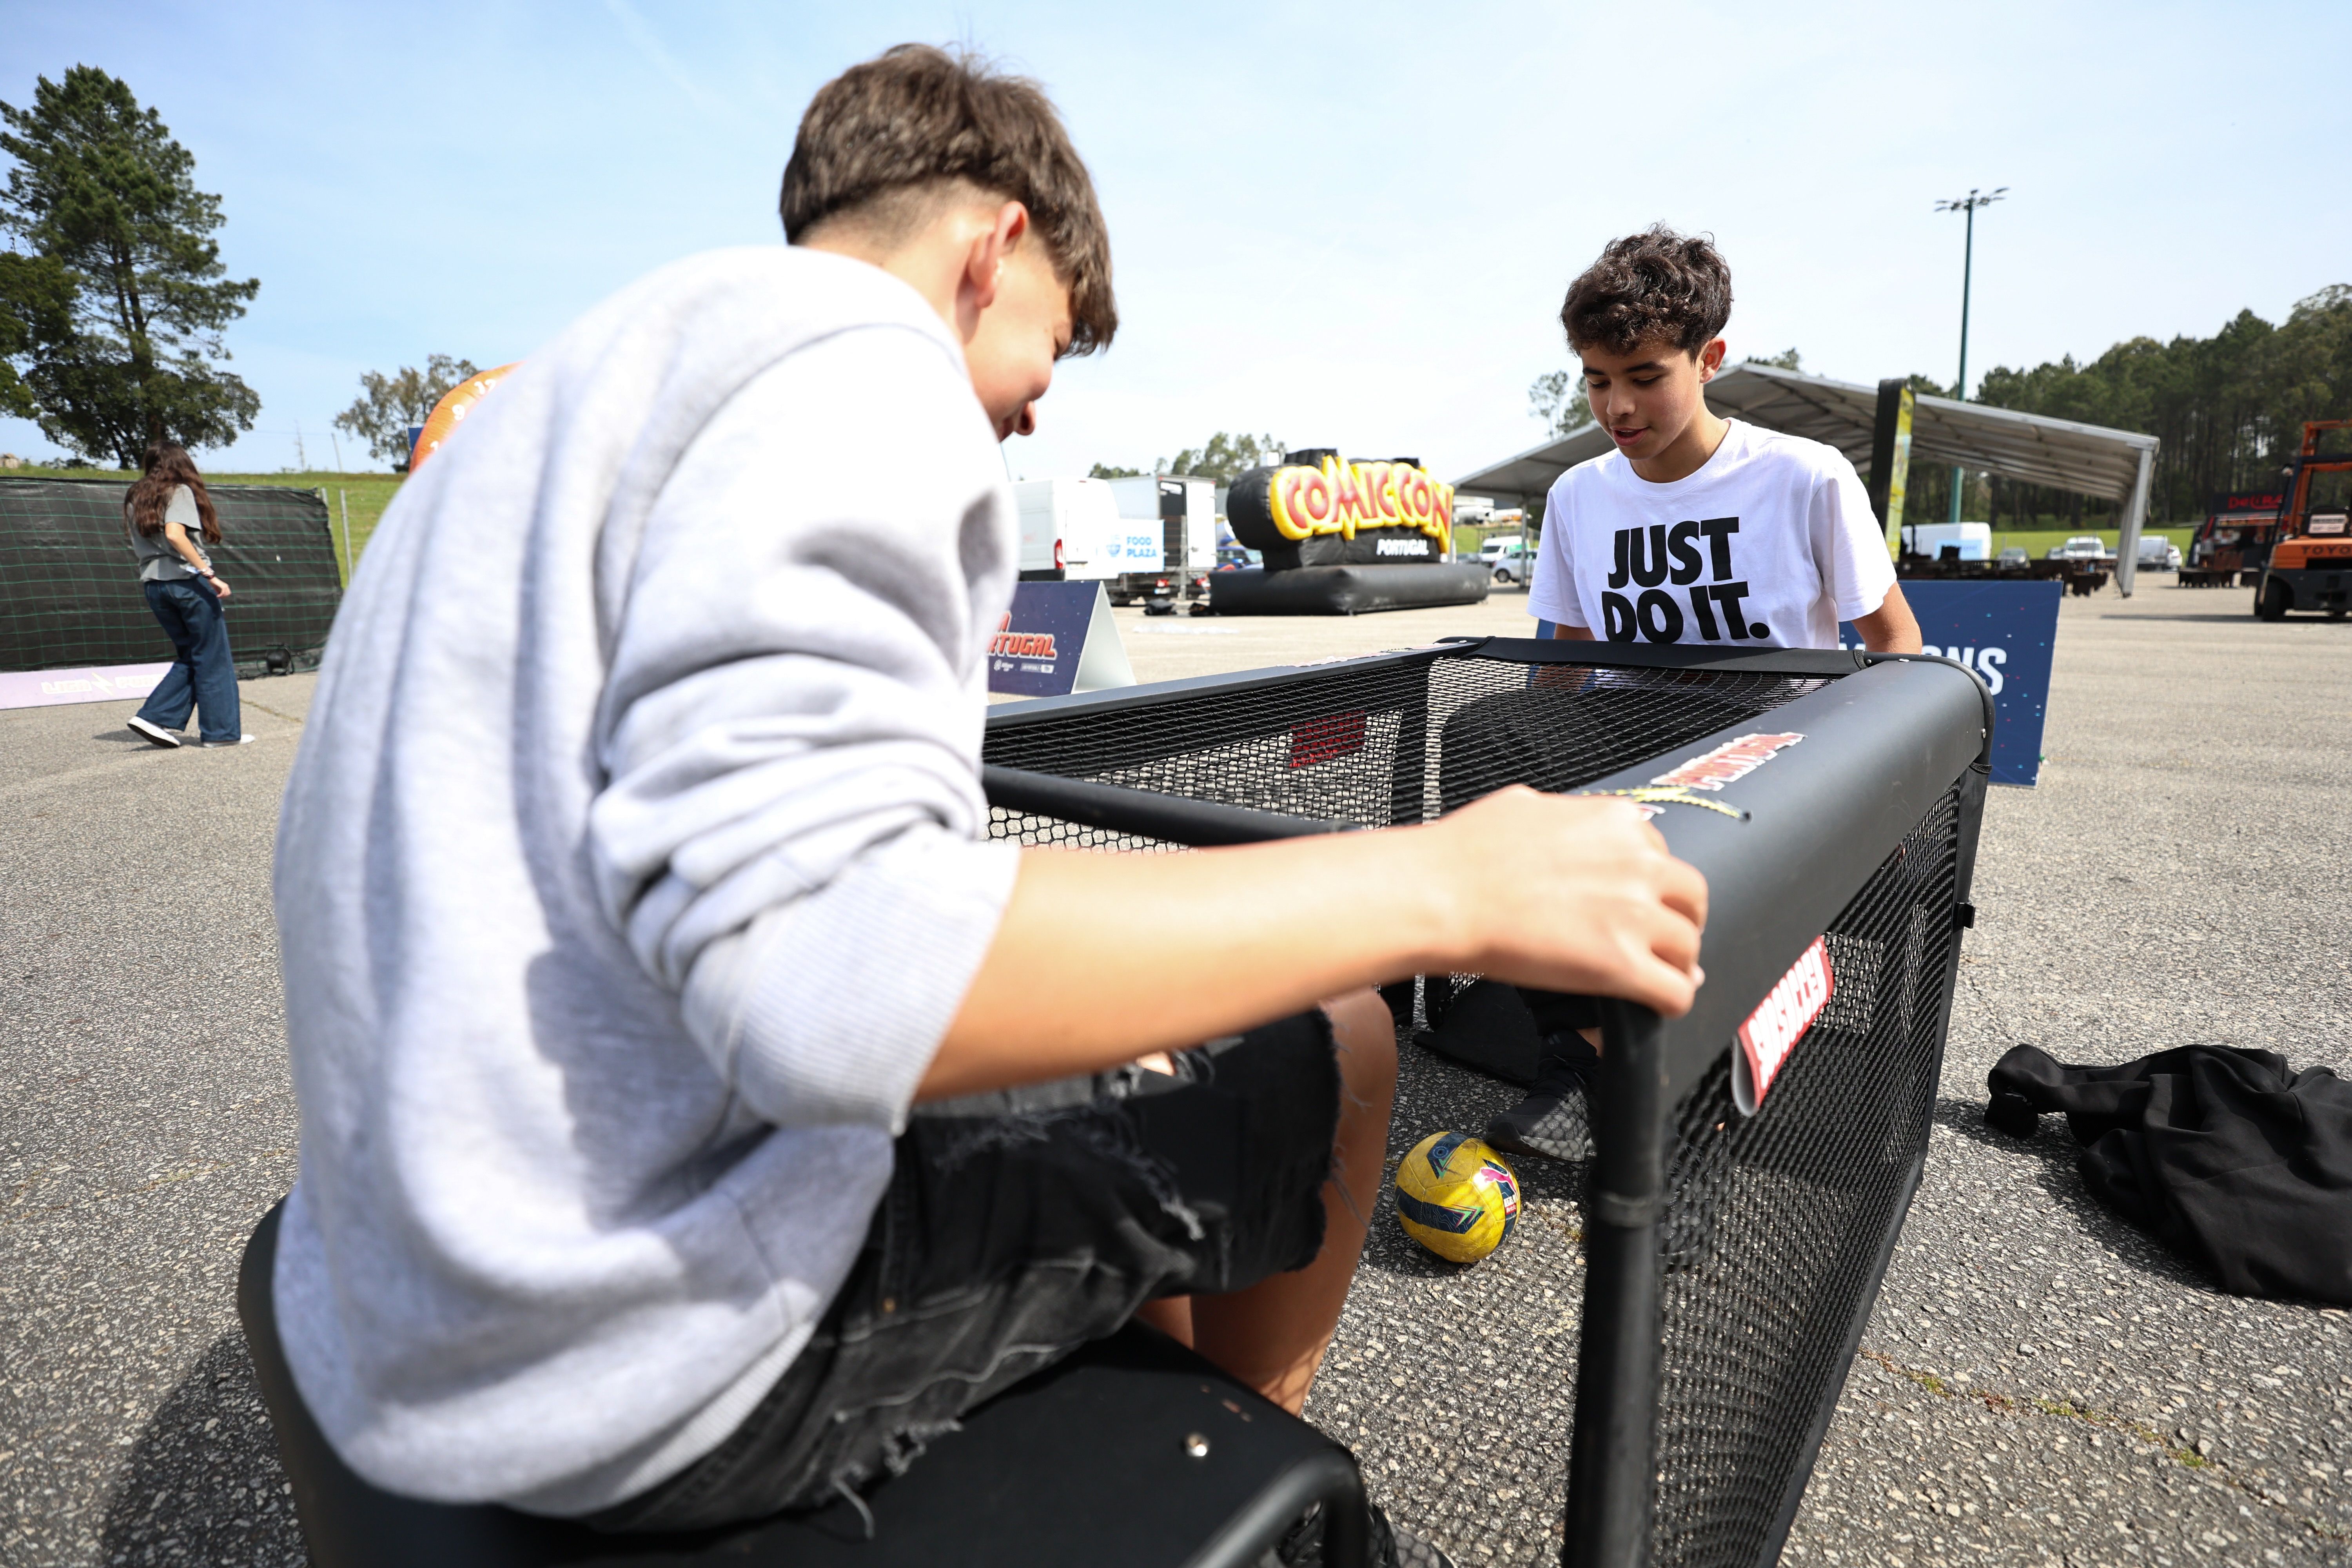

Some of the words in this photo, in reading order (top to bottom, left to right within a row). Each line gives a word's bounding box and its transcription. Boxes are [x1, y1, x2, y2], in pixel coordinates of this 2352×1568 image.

[452, 404, 465, 421] 9
[1126, 536, 1152, 546] FOOD
[1376, 539, 1429, 556] PORTUGAL
[1126, 549, 1157, 558] PLAZA
[1608, 517, 1739, 589] JUST
[1602, 589, 1684, 644] DO
[1689, 581, 1770, 641] IT.
